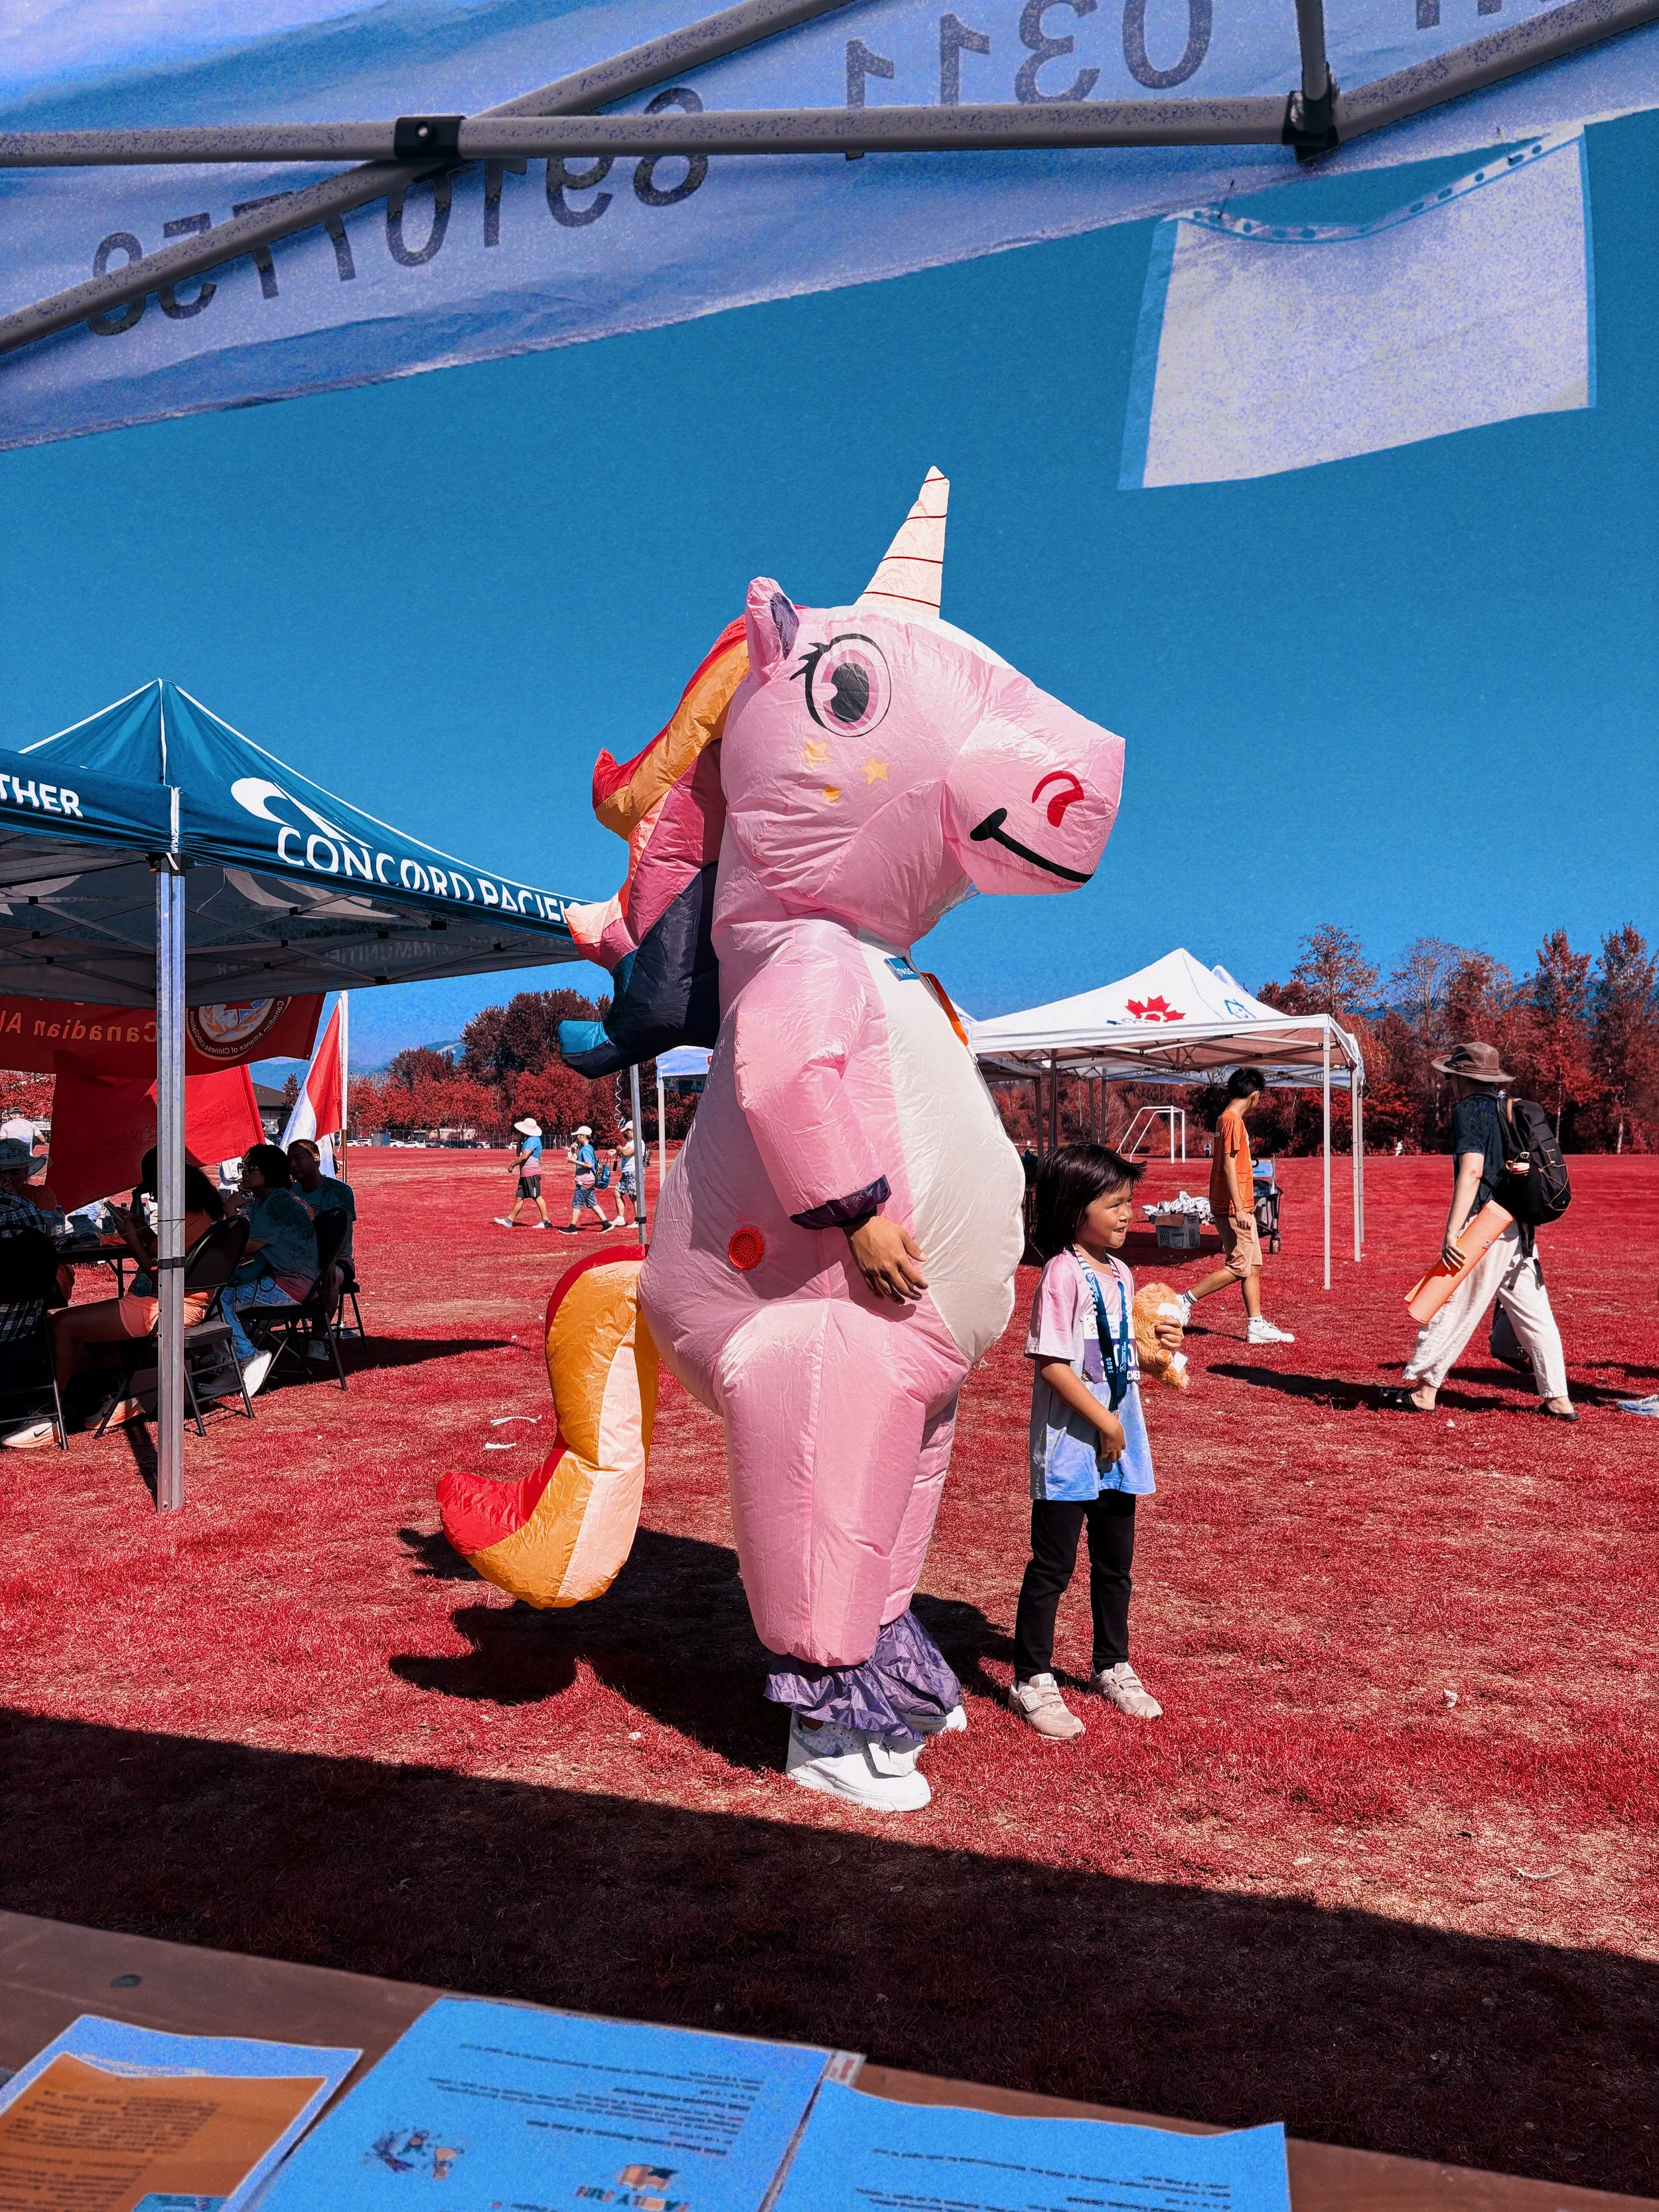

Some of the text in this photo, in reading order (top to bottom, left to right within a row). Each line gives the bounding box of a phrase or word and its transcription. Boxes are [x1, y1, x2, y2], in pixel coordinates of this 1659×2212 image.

[277, 826, 582, 924] CONCORD PACIFI
[1106, 1357, 1114, 1374] 2025
